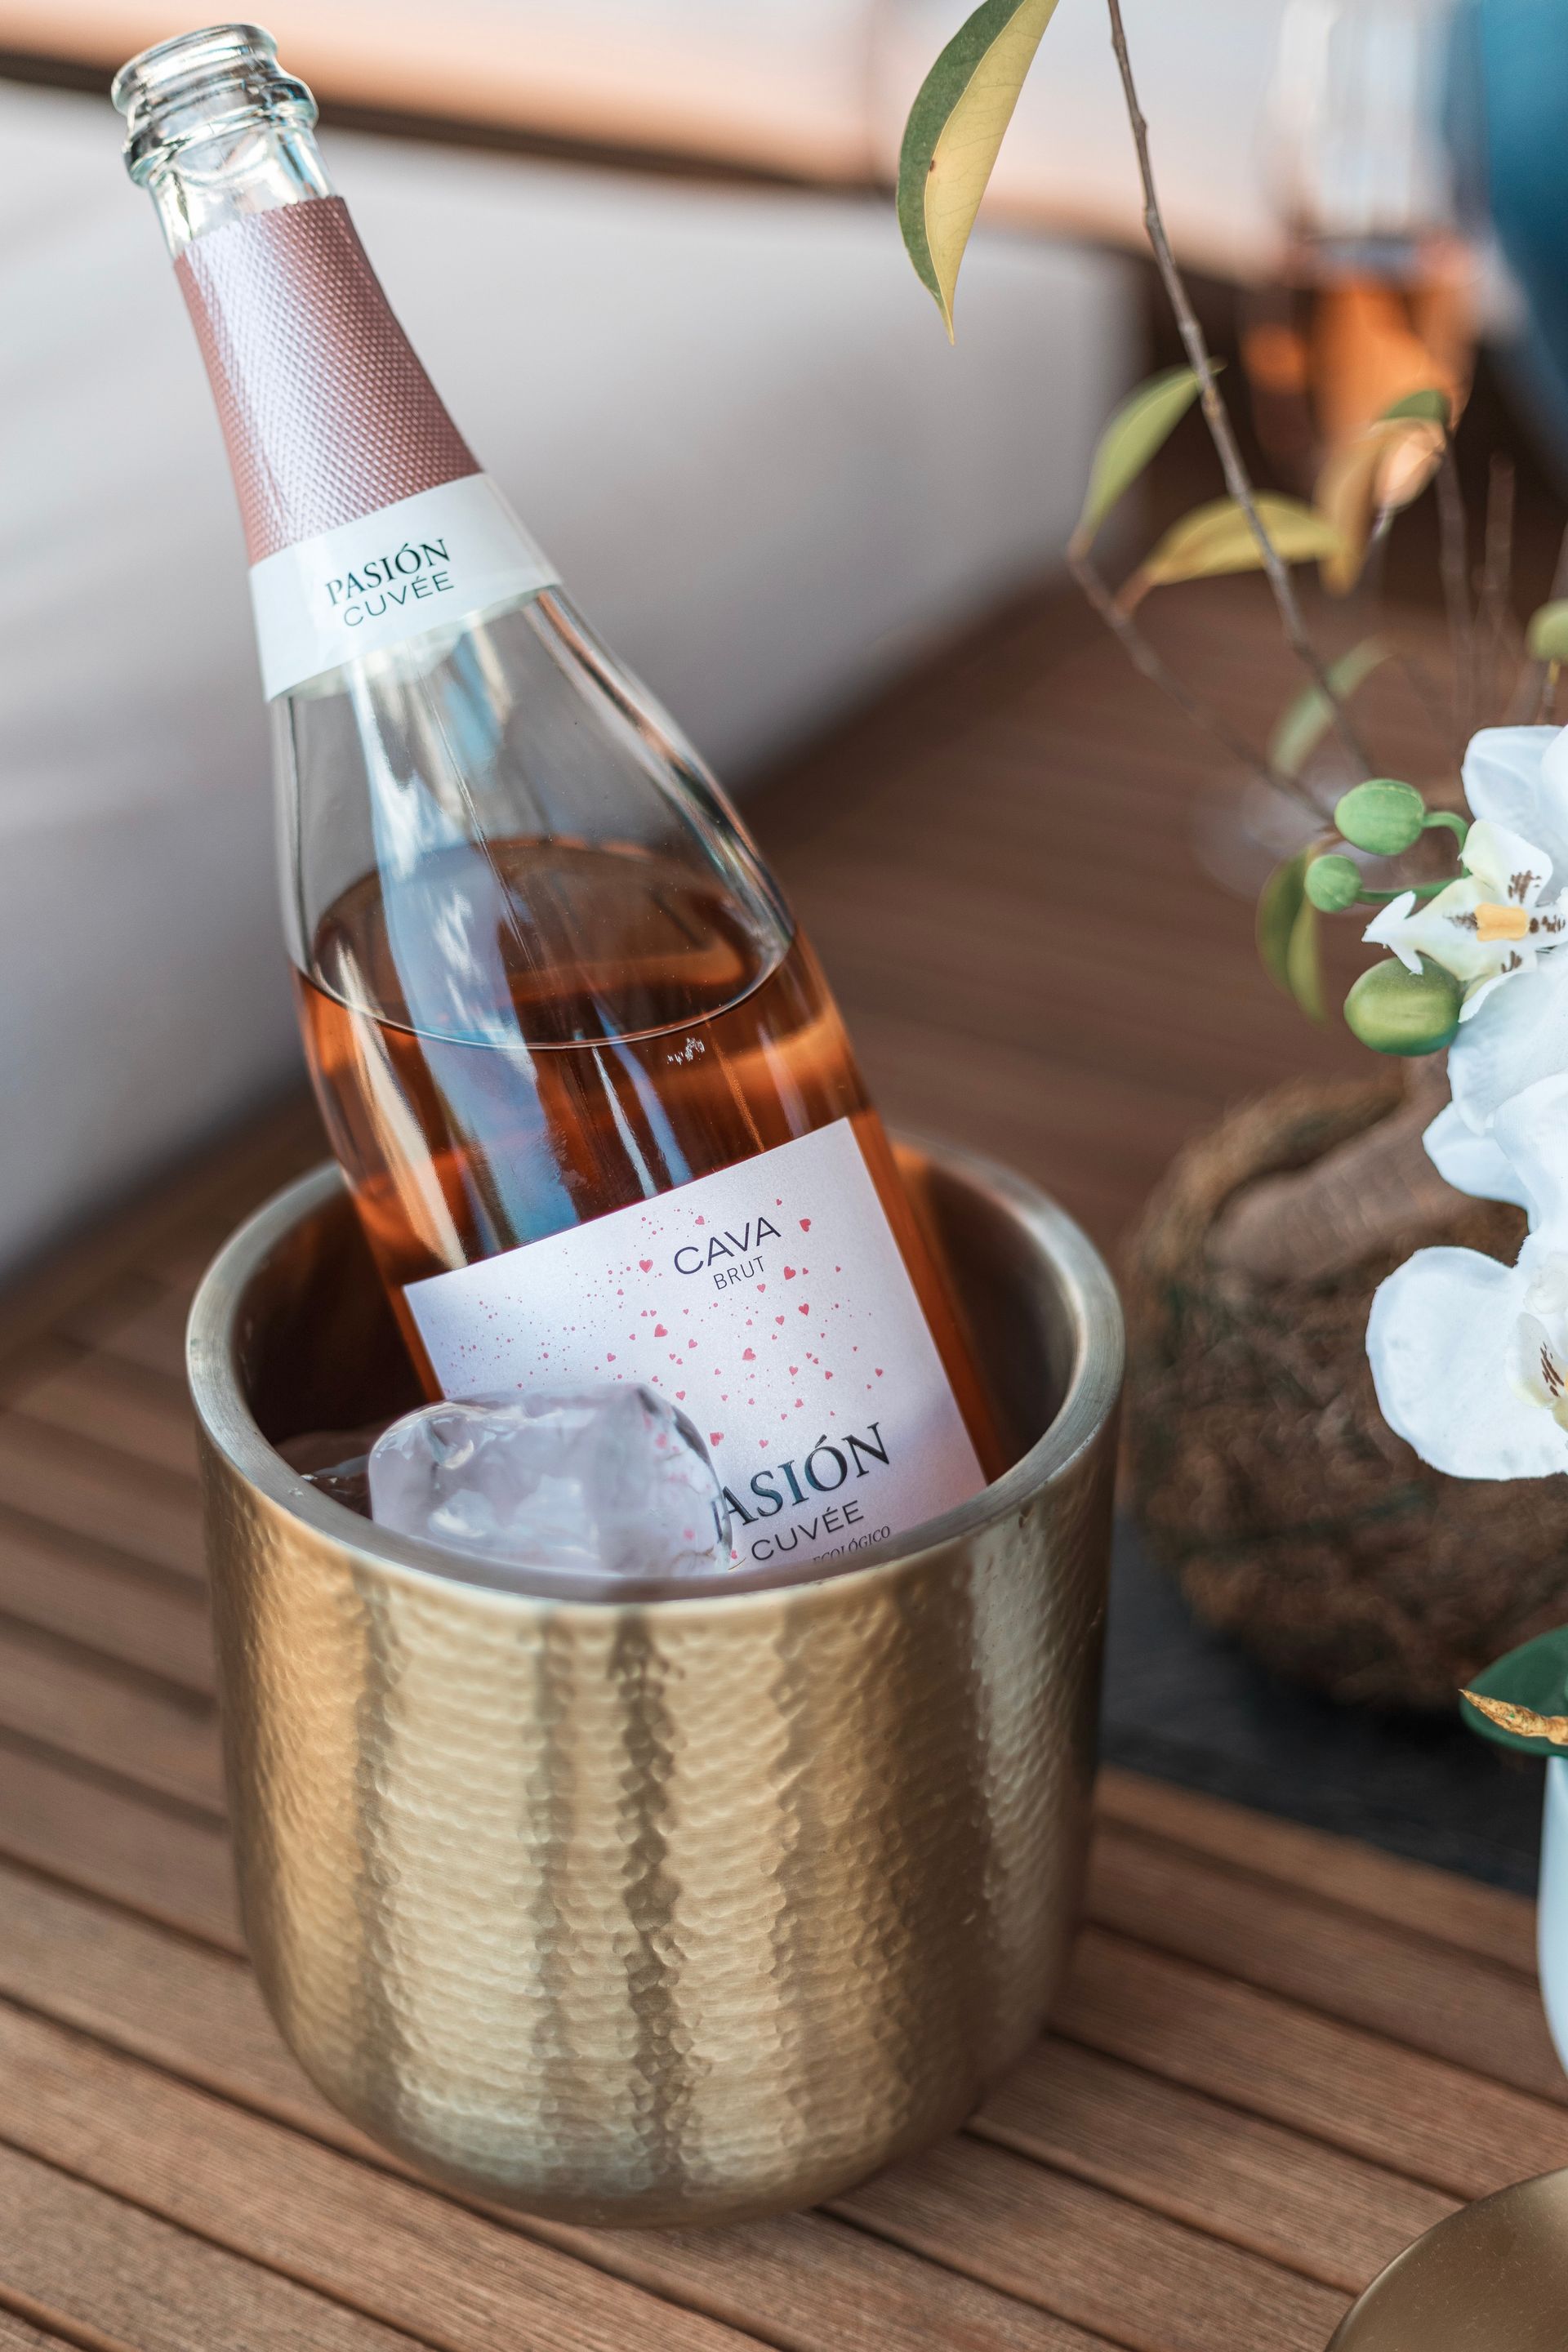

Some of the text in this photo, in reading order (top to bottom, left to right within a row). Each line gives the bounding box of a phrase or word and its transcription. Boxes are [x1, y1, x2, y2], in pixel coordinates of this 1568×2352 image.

[325, 539, 451, 606] PASIÓN
[343, 571, 454, 626] CUVÉE
[674, 1216, 782, 1275] CAVA
[713, 1255, 765, 1290] BRUT
[712, 1422, 890, 1541] ASIÓN
[751, 1499, 864, 1561] CUVÉE
